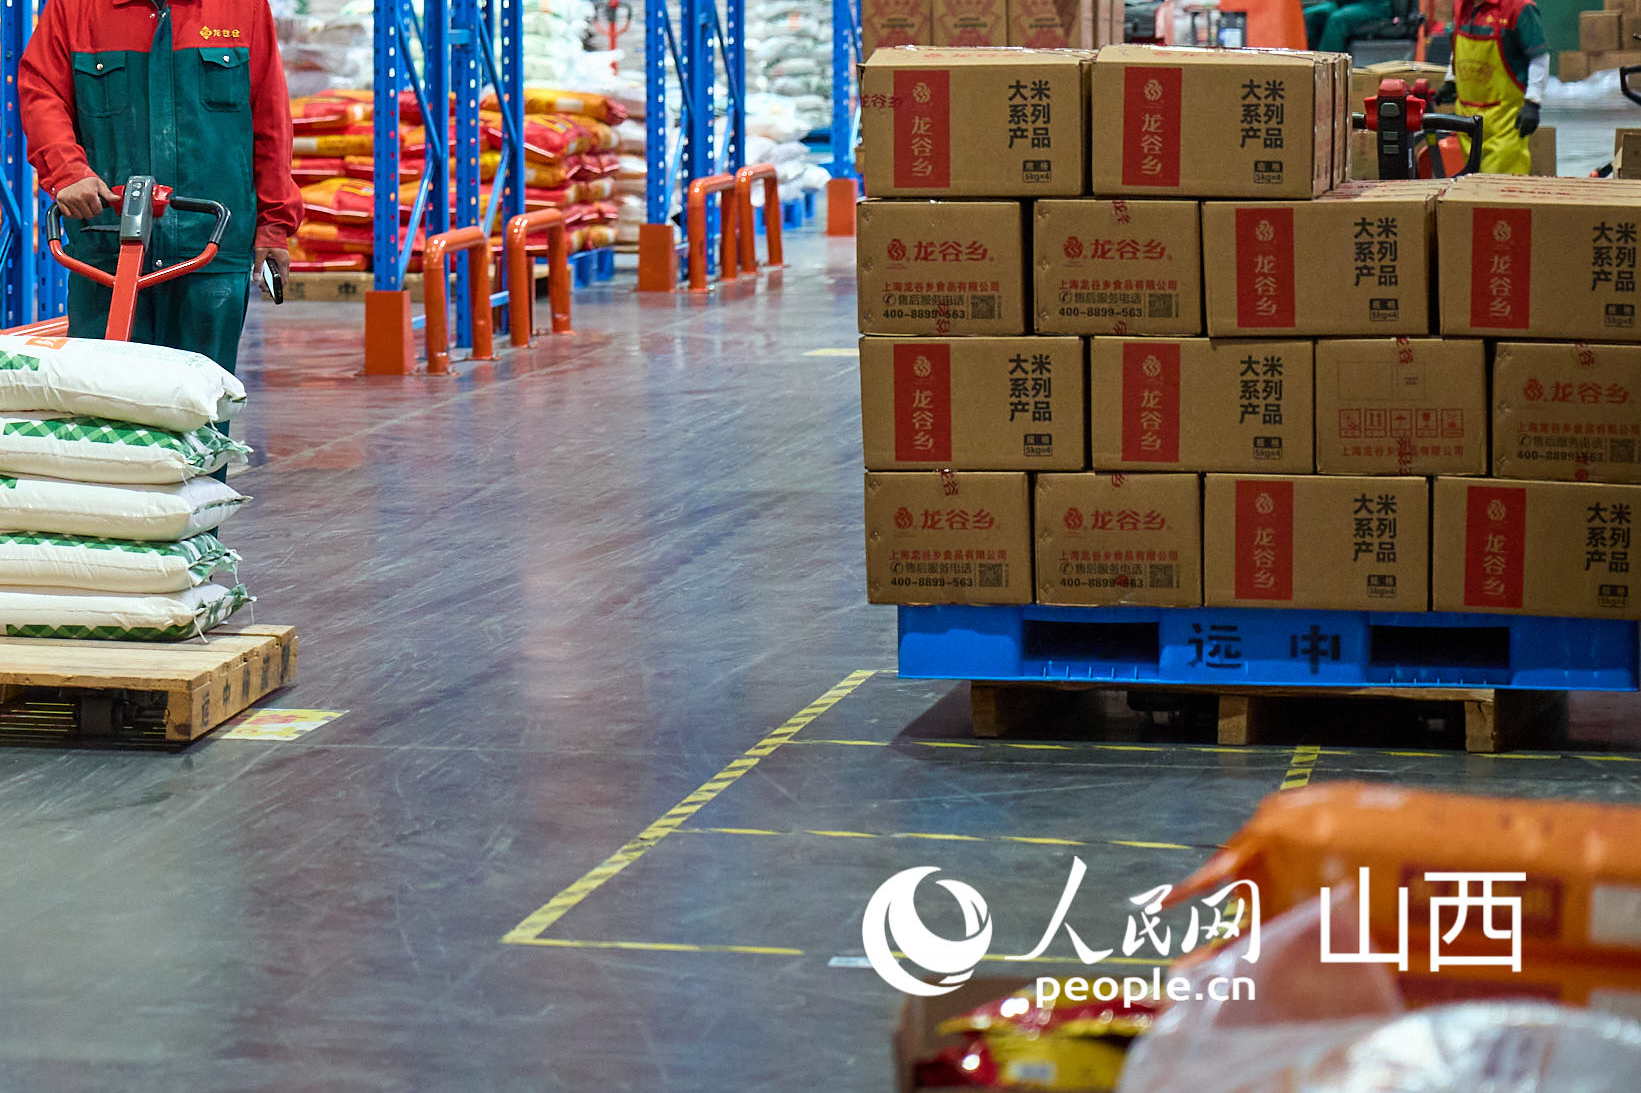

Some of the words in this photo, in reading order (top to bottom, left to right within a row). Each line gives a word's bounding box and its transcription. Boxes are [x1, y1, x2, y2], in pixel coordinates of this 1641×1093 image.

[1008, 80, 1052, 102] 大米
[1241, 79, 1284, 101] 大米
[1008, 104, 1052, 125] 系列
[1240, 104, 1284, 125] 系列
[911, 116, 934, 177] 龙谷乡
[1008, 127, 1052, 149] 产品
[1141, 114, 1163, 176] 龙谷乡
[1240, 127, 1284, 150] 产品
[1354, 217, 1398, 239] 大米
[1592, 222, 1637, 244] 大米
[914, 239, 989, 263] 龙谷乡
[1092, 239, 1167, 263] 龙谷乡
[1354, 242, 1398, 263] 系列
[1592, 245, 1637, 268] 系列
[1255, 255, 1278, 316] 龙谷乡
[1354, 265, 1398, 288] 产品
[1490, 255, 1511, 319] 龙谷乡
[1592, 269, 1637, 292] 产品
[1009, 354, 1052, 375] 大米
[1240, 355, 1283, 377] 大米
[1009, 377, 1052, 398] 系列
[1240, 379, 1283, 402] 系列
[1551, 380, 1630, 404] 龙谷乡
[912, 389, 934, 452] 龙谷乡
[1009, 400, 1052, 423] 产品
[1140, 389, 1162, 451] 龙谷乡
[1240, 403, 1283, 425] 产品
[1354, 494, 1397, 515] 大米
[1586, 503, 1631, 524] 大米
[921, 509, 995, 530] 龙谷乡
[1091, 509, 1165, 530] 龙谷乡
[1354, 517, 1396, 538] 系列
[1586, 527, 1631, 548] 系列
[1254, 528, 1275, 588] 龙谷乡
[1354, 542, 1396, 563] 产品
[1586, 550, 1629, 572] 产品
[1485, 534, 1506, 595] 龙谷乡
[1188, 624, 1340, 674] 远中
